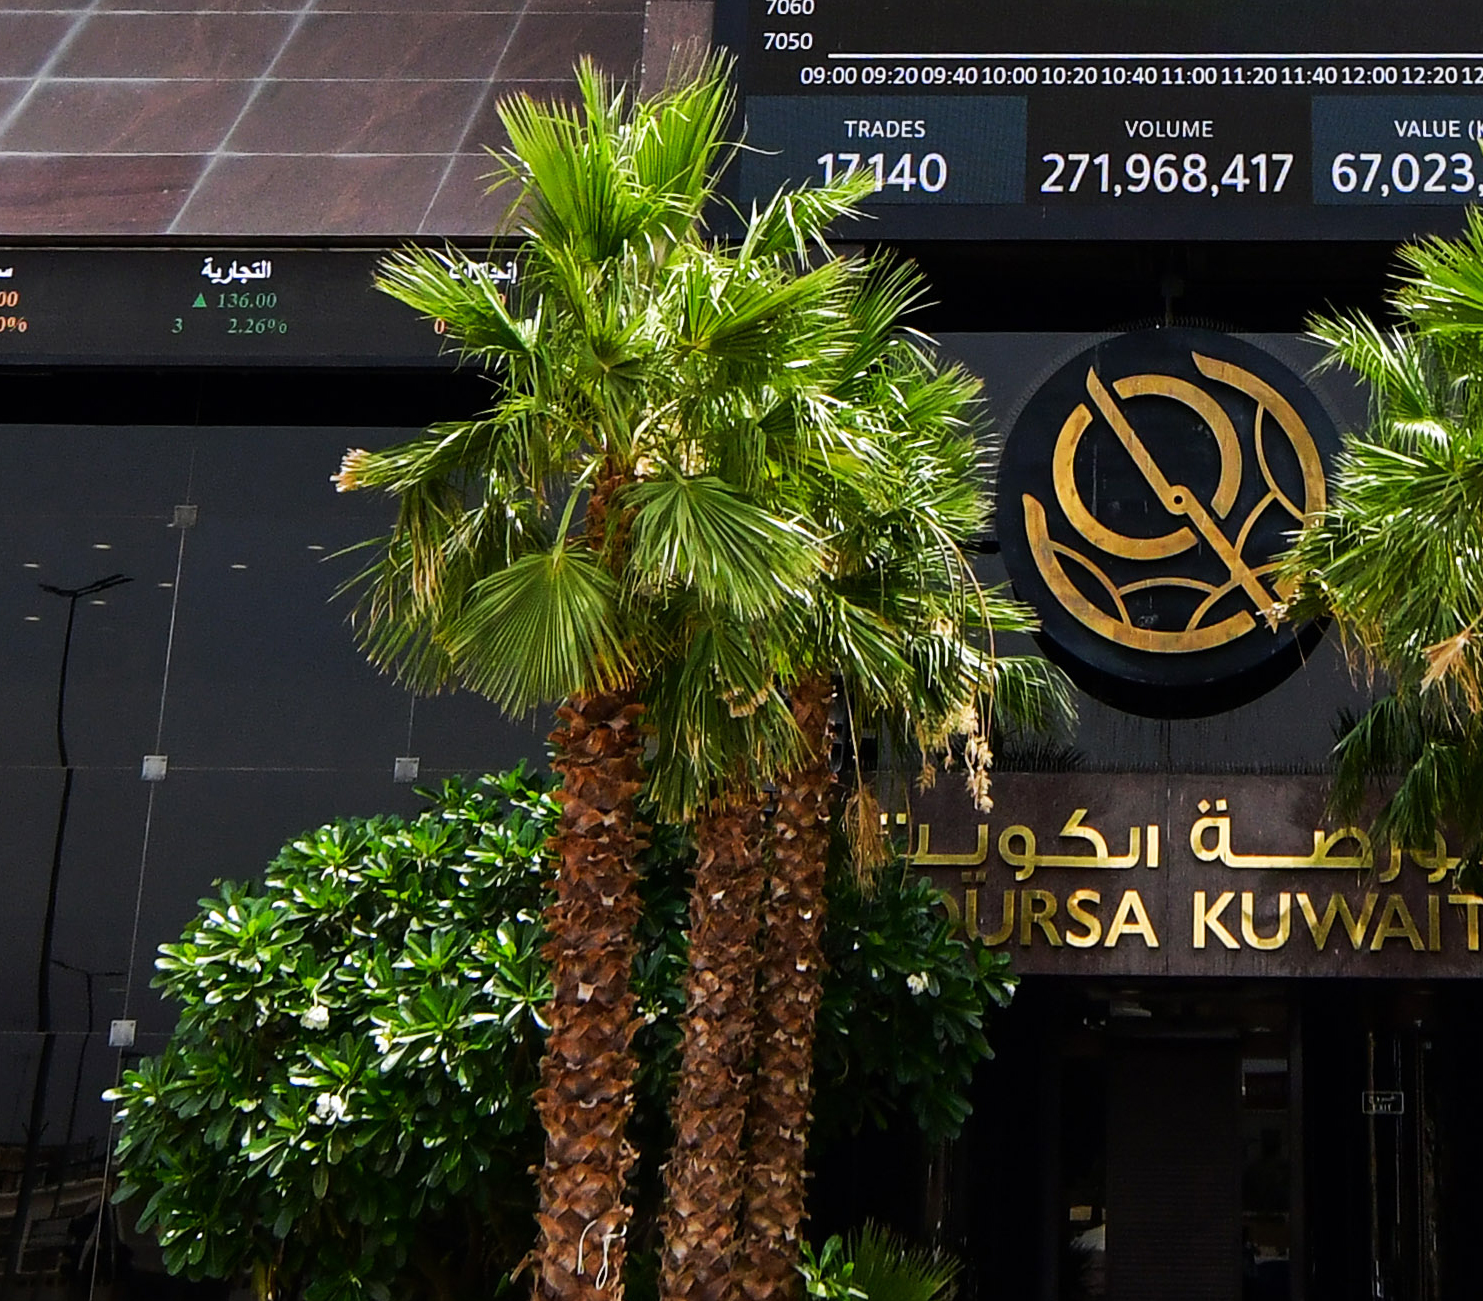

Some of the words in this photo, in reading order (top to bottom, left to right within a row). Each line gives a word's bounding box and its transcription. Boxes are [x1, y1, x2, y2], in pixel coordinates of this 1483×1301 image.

[763, 32, 813, 51] 7050
[800, 66, 858, 85] 09:00
[861, 66, 919, 85] 09:20
[921, 66, 978, 85] 09:40
[981, 66, 1038, 85] 10:00
[1041, 66, 1098, 85] 10:20
[1101, 66, 1158, 85] 10:40
[1161, 66, 1218, 85] 11:00
[1221, 66, 1278, 85] 11:20
[1281, 66, 1338, 85] 11:40
[1341, 66, 1398, 85] 12:00
[1401, 66, 1458, 85] 12:20
[843, 120, 926, 139] TRADES
[1124, 120, 1214, 138] VOLUME
[1393, 119, 1462, 138] VALUE
[1040, 153, 1294, 198] 271,968,417
[200, 256, 272, 285] التجارية
[217, 292, 278, 309] 136.00
[171, 317, 183, 334] 3
[227, 317, 288, 334] 2.26%
[1190, 799, 1462, 883] ورصة
[1193, 891, 1483, 951] KUWAIT
